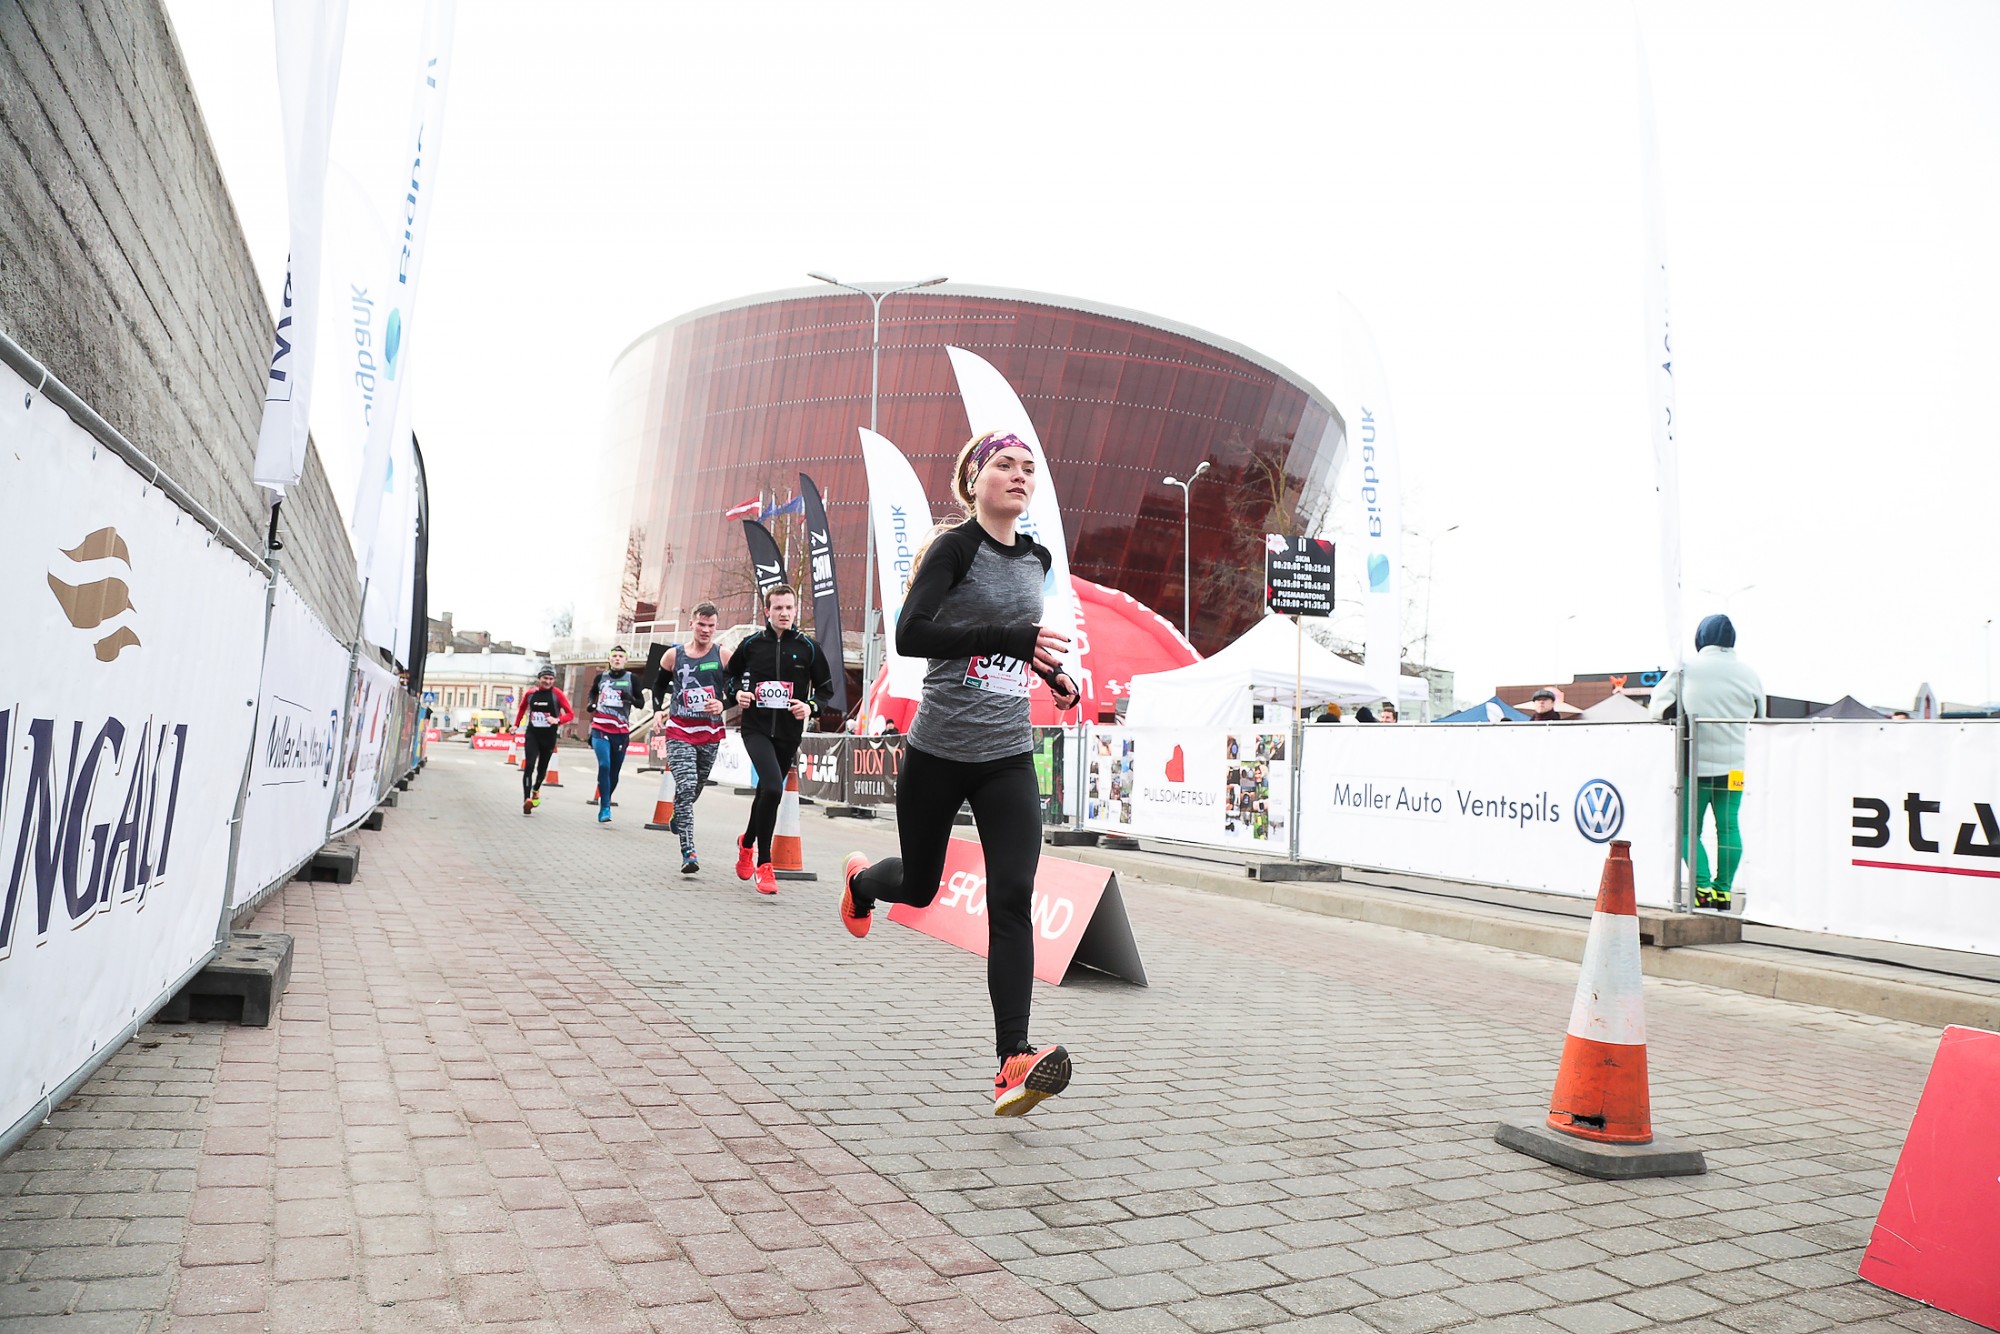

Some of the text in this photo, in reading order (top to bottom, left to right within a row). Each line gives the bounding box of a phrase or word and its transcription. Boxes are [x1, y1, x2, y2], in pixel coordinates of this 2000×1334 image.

[1277, 590, 1326, 601] PUSMARATONS
[759, 688, 789, 698] 3004
[853, 748, 885, 775] DION
[1333, 783, 1391, 809] Møller
[1396, 786, 1442, 813] Auto
[1457, 790, 1560, 828] Ventspils
